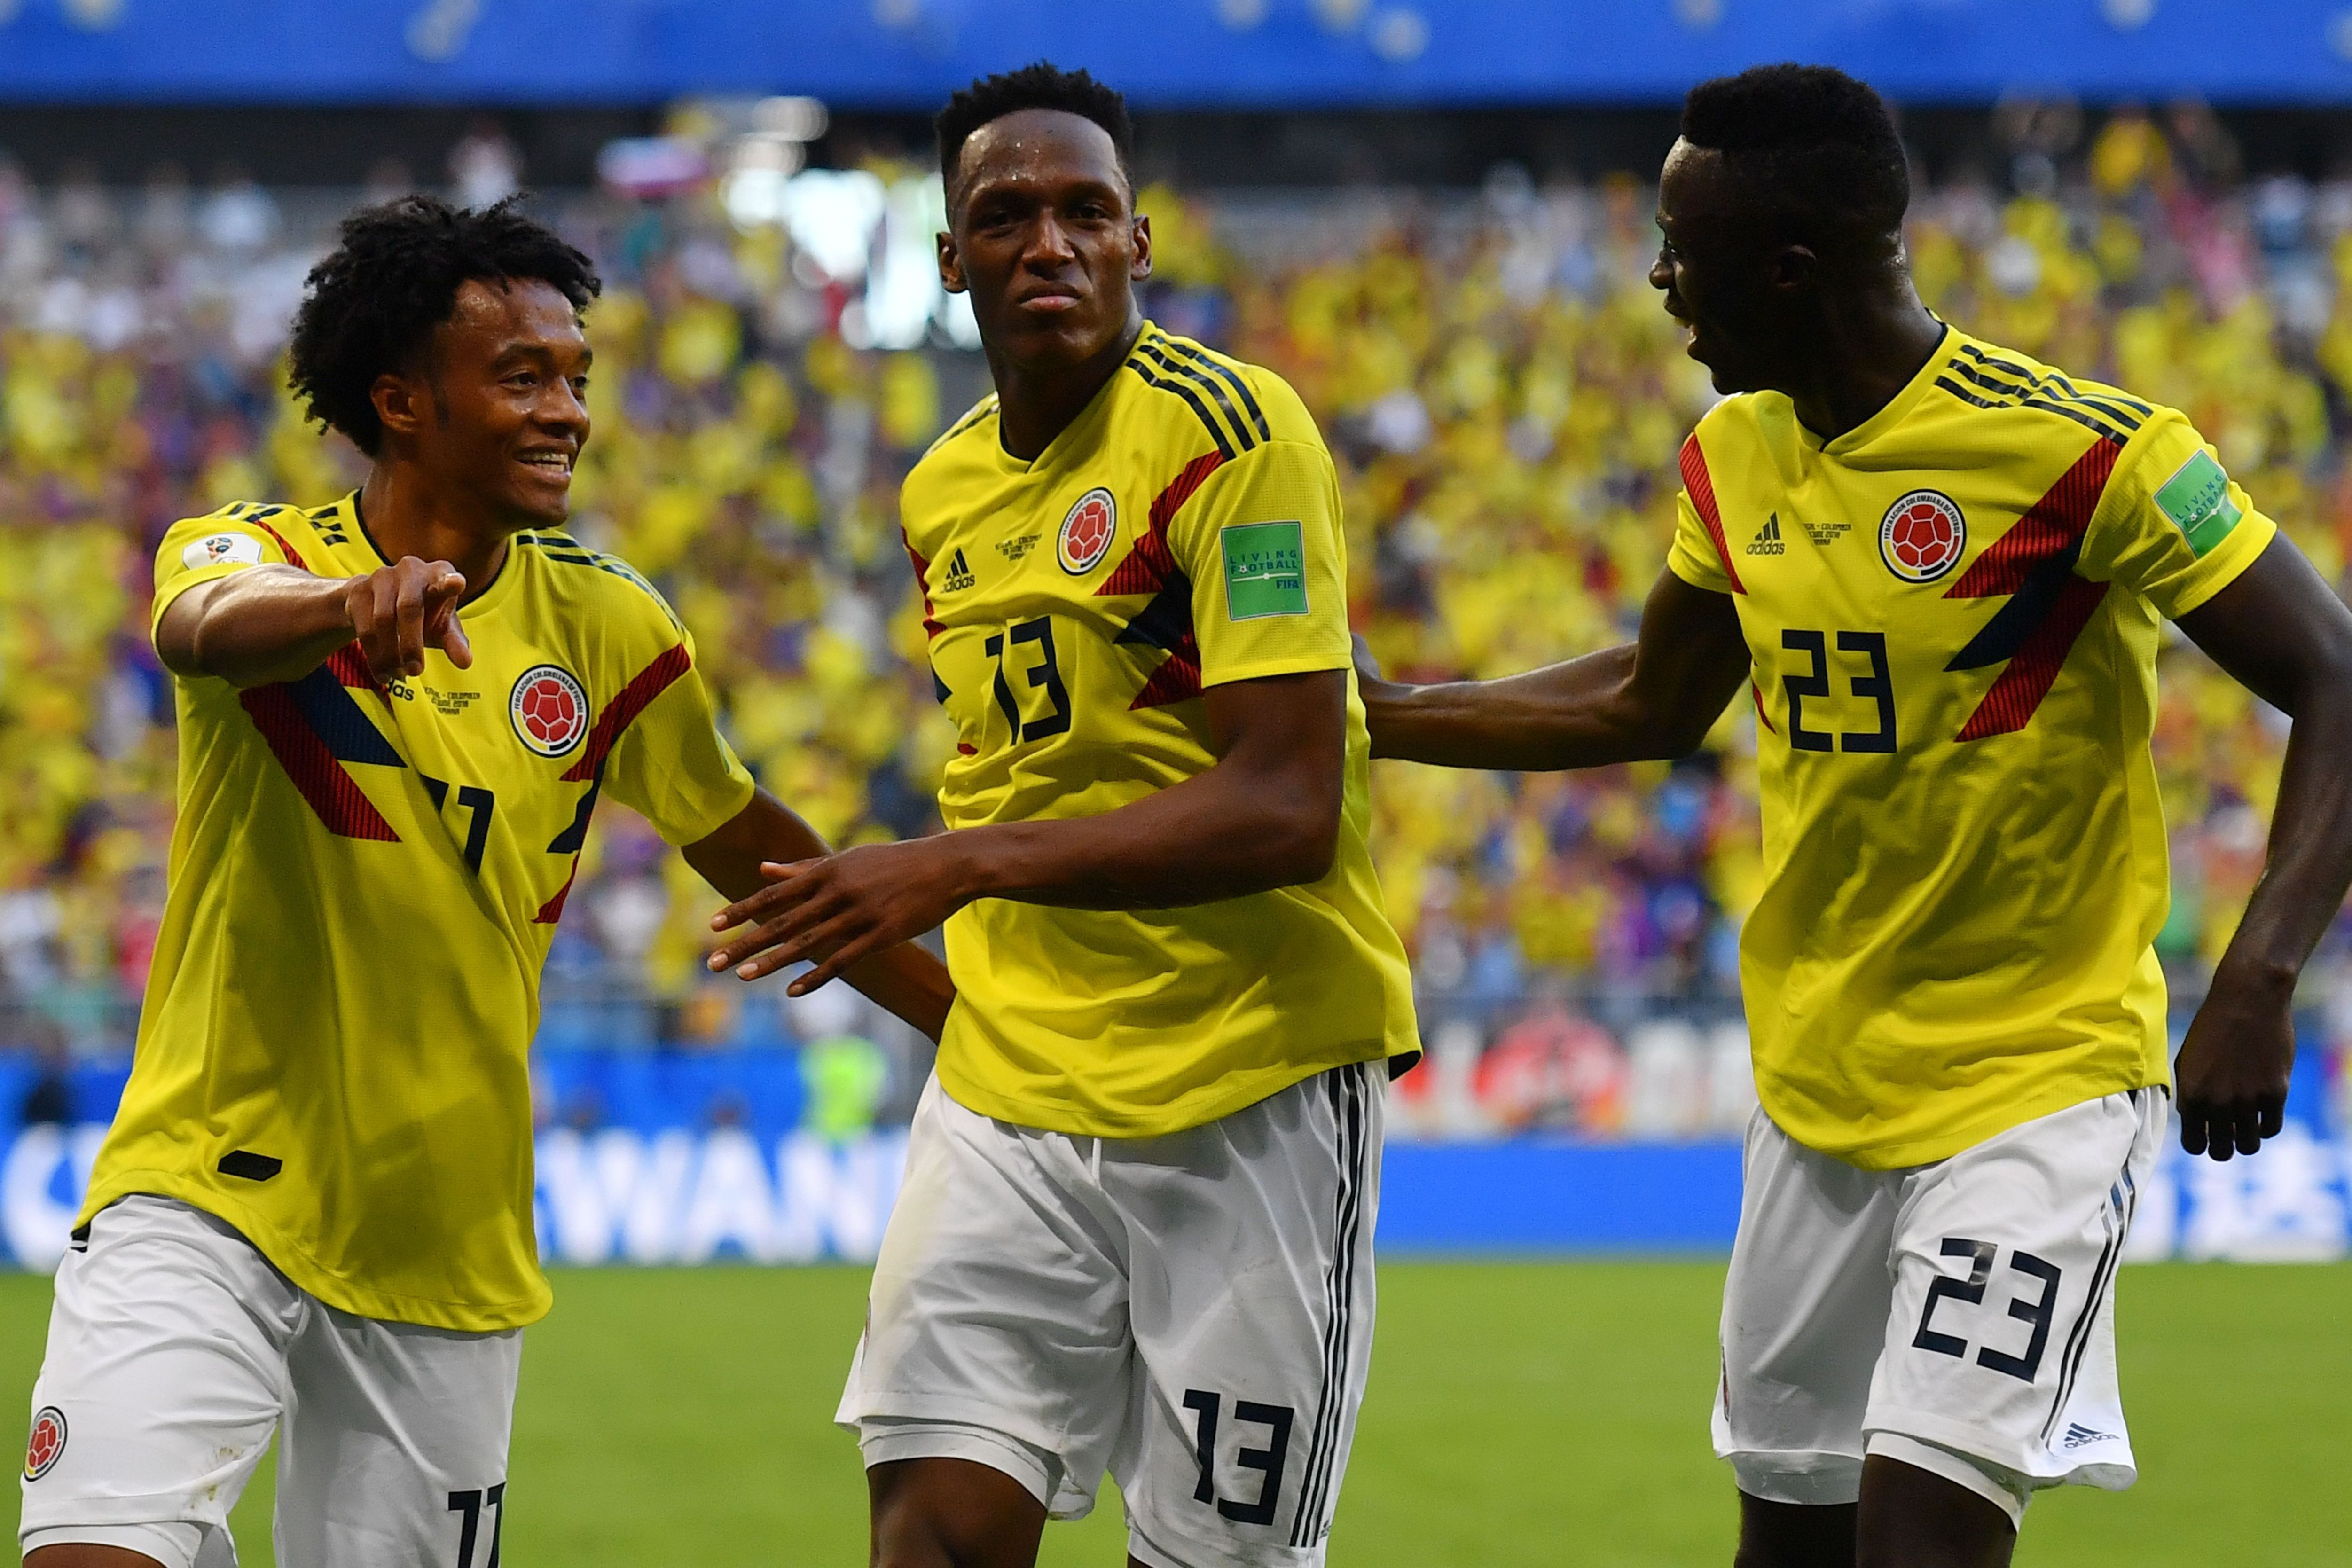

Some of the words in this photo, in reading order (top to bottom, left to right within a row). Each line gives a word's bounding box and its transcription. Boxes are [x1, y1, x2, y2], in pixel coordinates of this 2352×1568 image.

[2176, 473, 2222, 519] LIVING
[1230, 550, 1297, 564] LIVING
[1746, 539, 1785, 555] adidas
[1276, 580, 1299, 589] FIFA
[985, 615, 1071, 747] 13
[1782, 629, 1897, 753] 23
[1912, 1238, 2062, 1384] 23
[1183, 1389, 1295, 1526] 13
[2064, 1434, 2120, 1449] adidas
